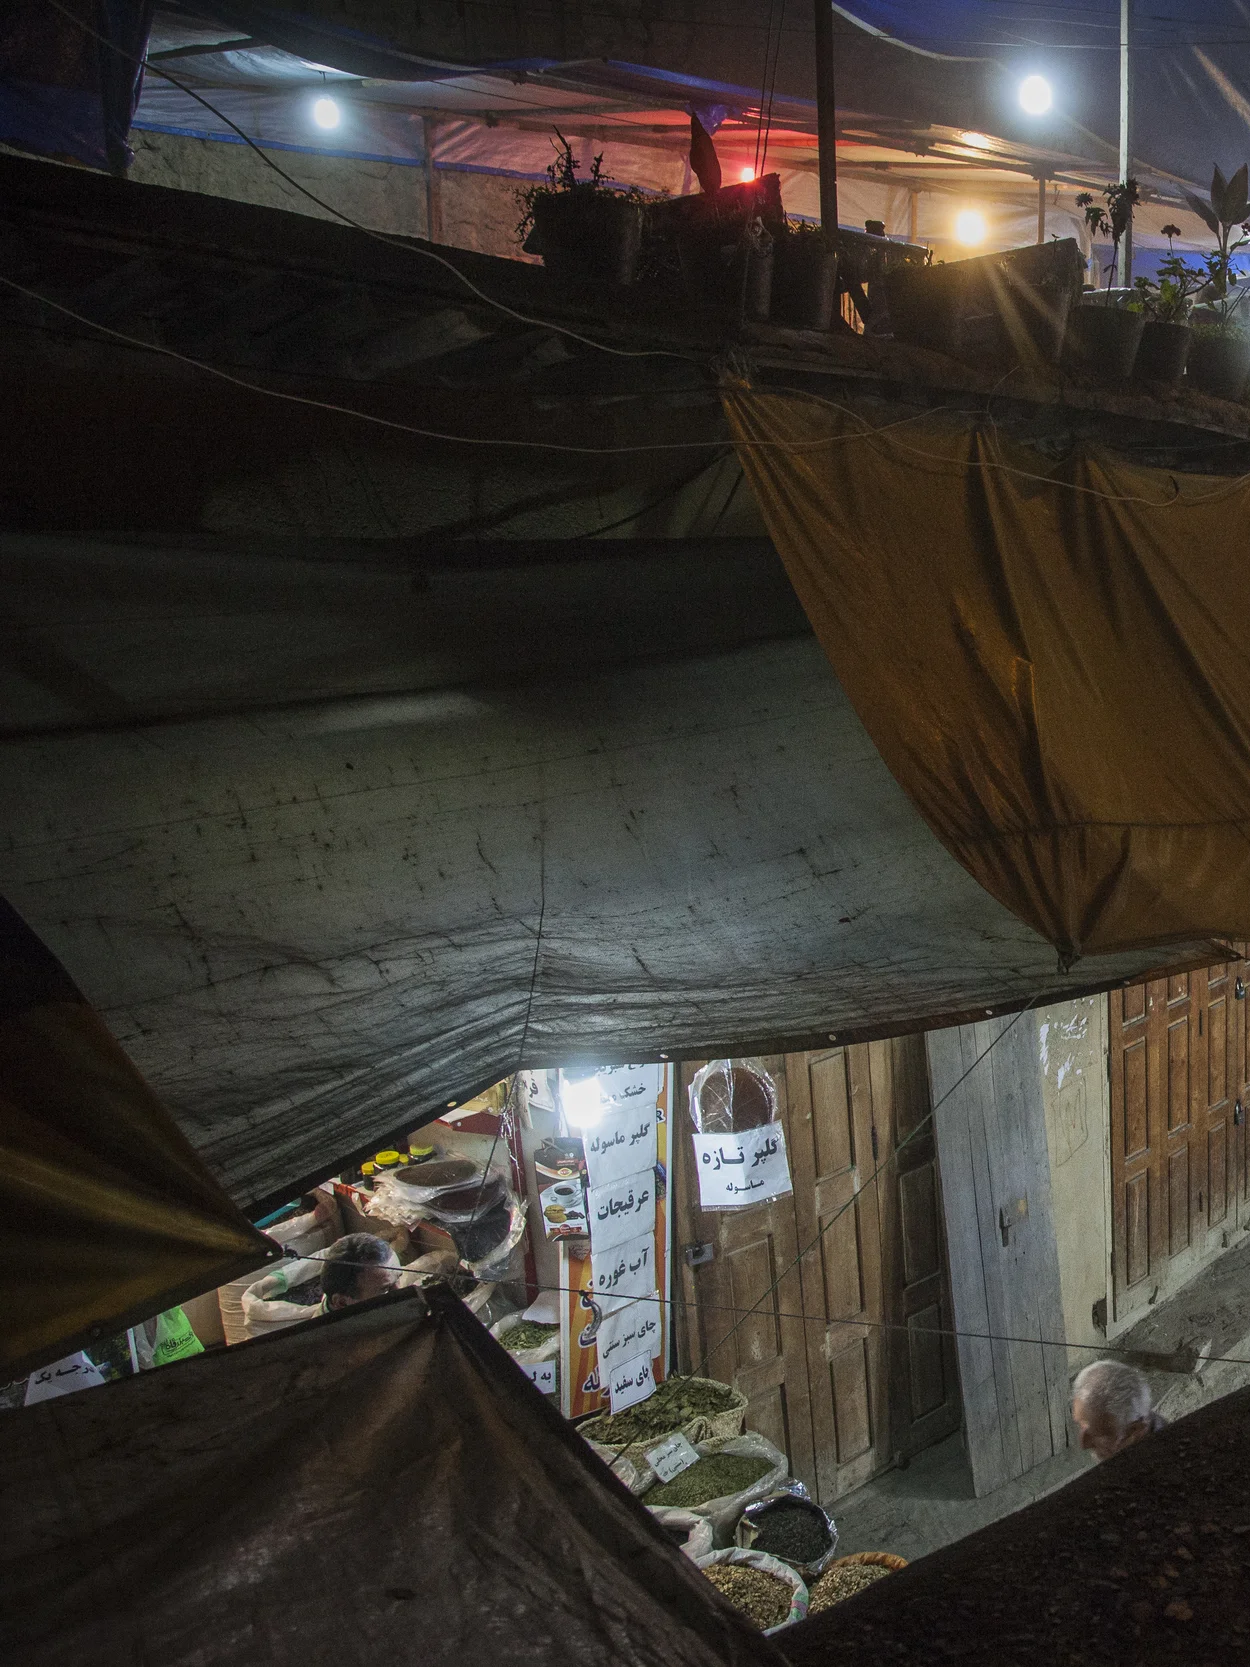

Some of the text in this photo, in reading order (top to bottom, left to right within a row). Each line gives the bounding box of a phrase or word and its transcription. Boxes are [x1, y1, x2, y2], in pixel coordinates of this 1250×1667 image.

[590, 1131, 626, 1155] ماسوله
[702, 1136, 779, 1171] گلپر تازه
[725, 1179, 765, 1195] ماسوله
[597, 1189, 649, 1221] عرقیجات
[598, 1246, 650, 1290] آب غوره
[621, 1331, 636, 1348] سبز
[637, 1320, 657, 1339] چای
